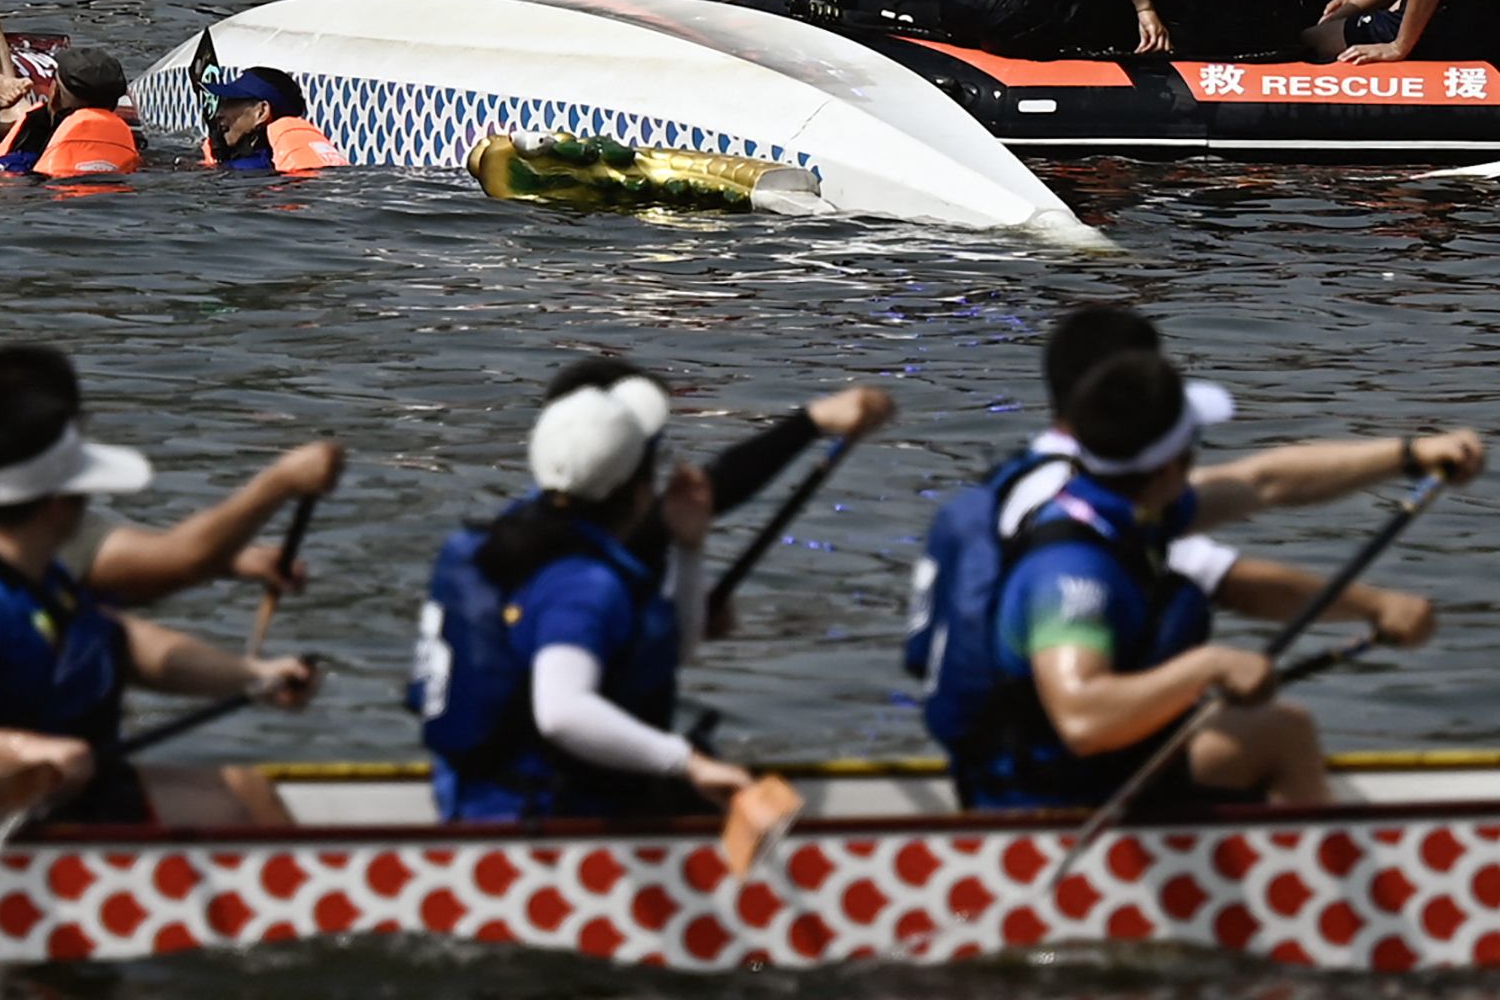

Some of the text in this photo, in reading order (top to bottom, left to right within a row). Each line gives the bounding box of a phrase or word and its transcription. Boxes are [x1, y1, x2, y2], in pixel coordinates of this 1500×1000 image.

[1199, 64, 1487, 99] 救 RESCUE 援
